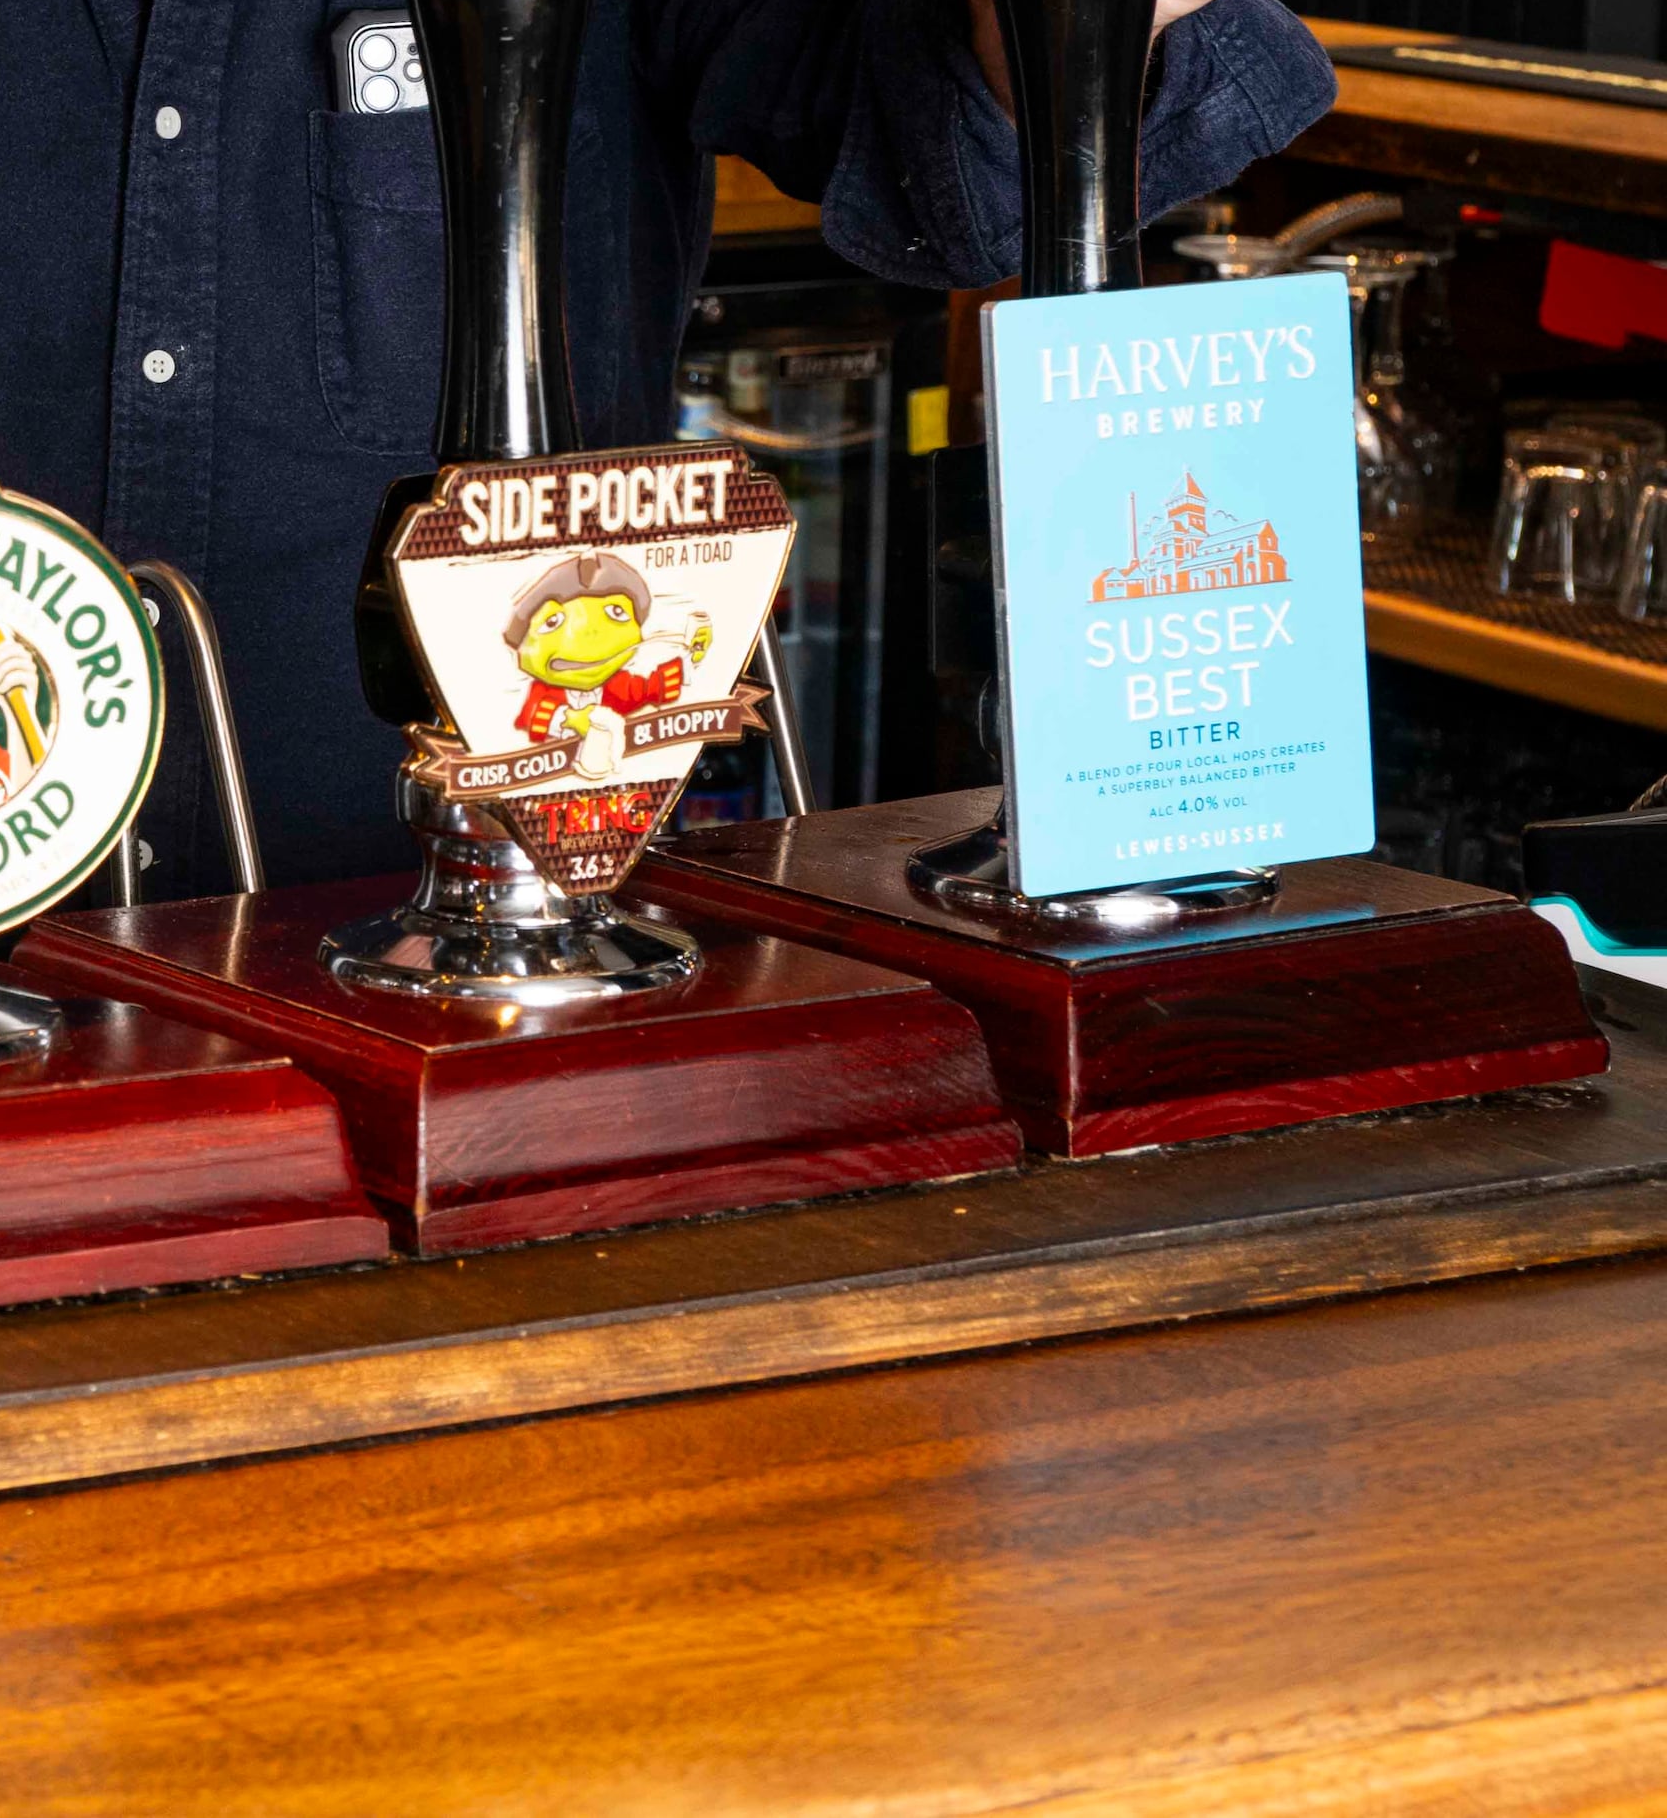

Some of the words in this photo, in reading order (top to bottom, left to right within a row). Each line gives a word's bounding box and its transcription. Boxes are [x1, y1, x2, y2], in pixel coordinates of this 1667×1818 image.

[1039, 325, 1317, 404] HARVEY'S
[1097, 398, 1265, 439] BREWERY
[458, 475, 558, 546] SIDE
[568, 459, 734, 536] POCKET
[645, 545, 675, 569] FOR
[679, 543, 689, 566] A
[694, 540, 733, 565] TOAD
[1085, 599, 1295, 668] SUSSEX
[1125, 661, 1260, 723] BEST
[513, 750, 568, 781] GOLD
[633, 724, 653, 746] &
[657, 708, 730, 740] HOPPY
[1149, 720, 1242, 751] BITTER
[1078, 767, 1121, 782] BLEND
[1126, 763, 1143, 777] OF
[1147, 759, 1183, 774] FOUR
[1186, 753, 1228, 769] LOCAL
[1233, 748, 1266, 763] HOPS
[1270, 741, 1326, 758] CREATES
[1111, 777, 1175, 795] SUPERBLY
[1179, 767, 1248, 787] BALANCED
[1252, 761, 1297, 778] BITTER
[536, 791, 654, 846] TRING
[1149, 805, 1174, 818] ALC
[1178, 796, 1219, 814] 4.0%
[1222, 796, 1249, 809] VOL
[569, 854, 599, 881] 3.6
